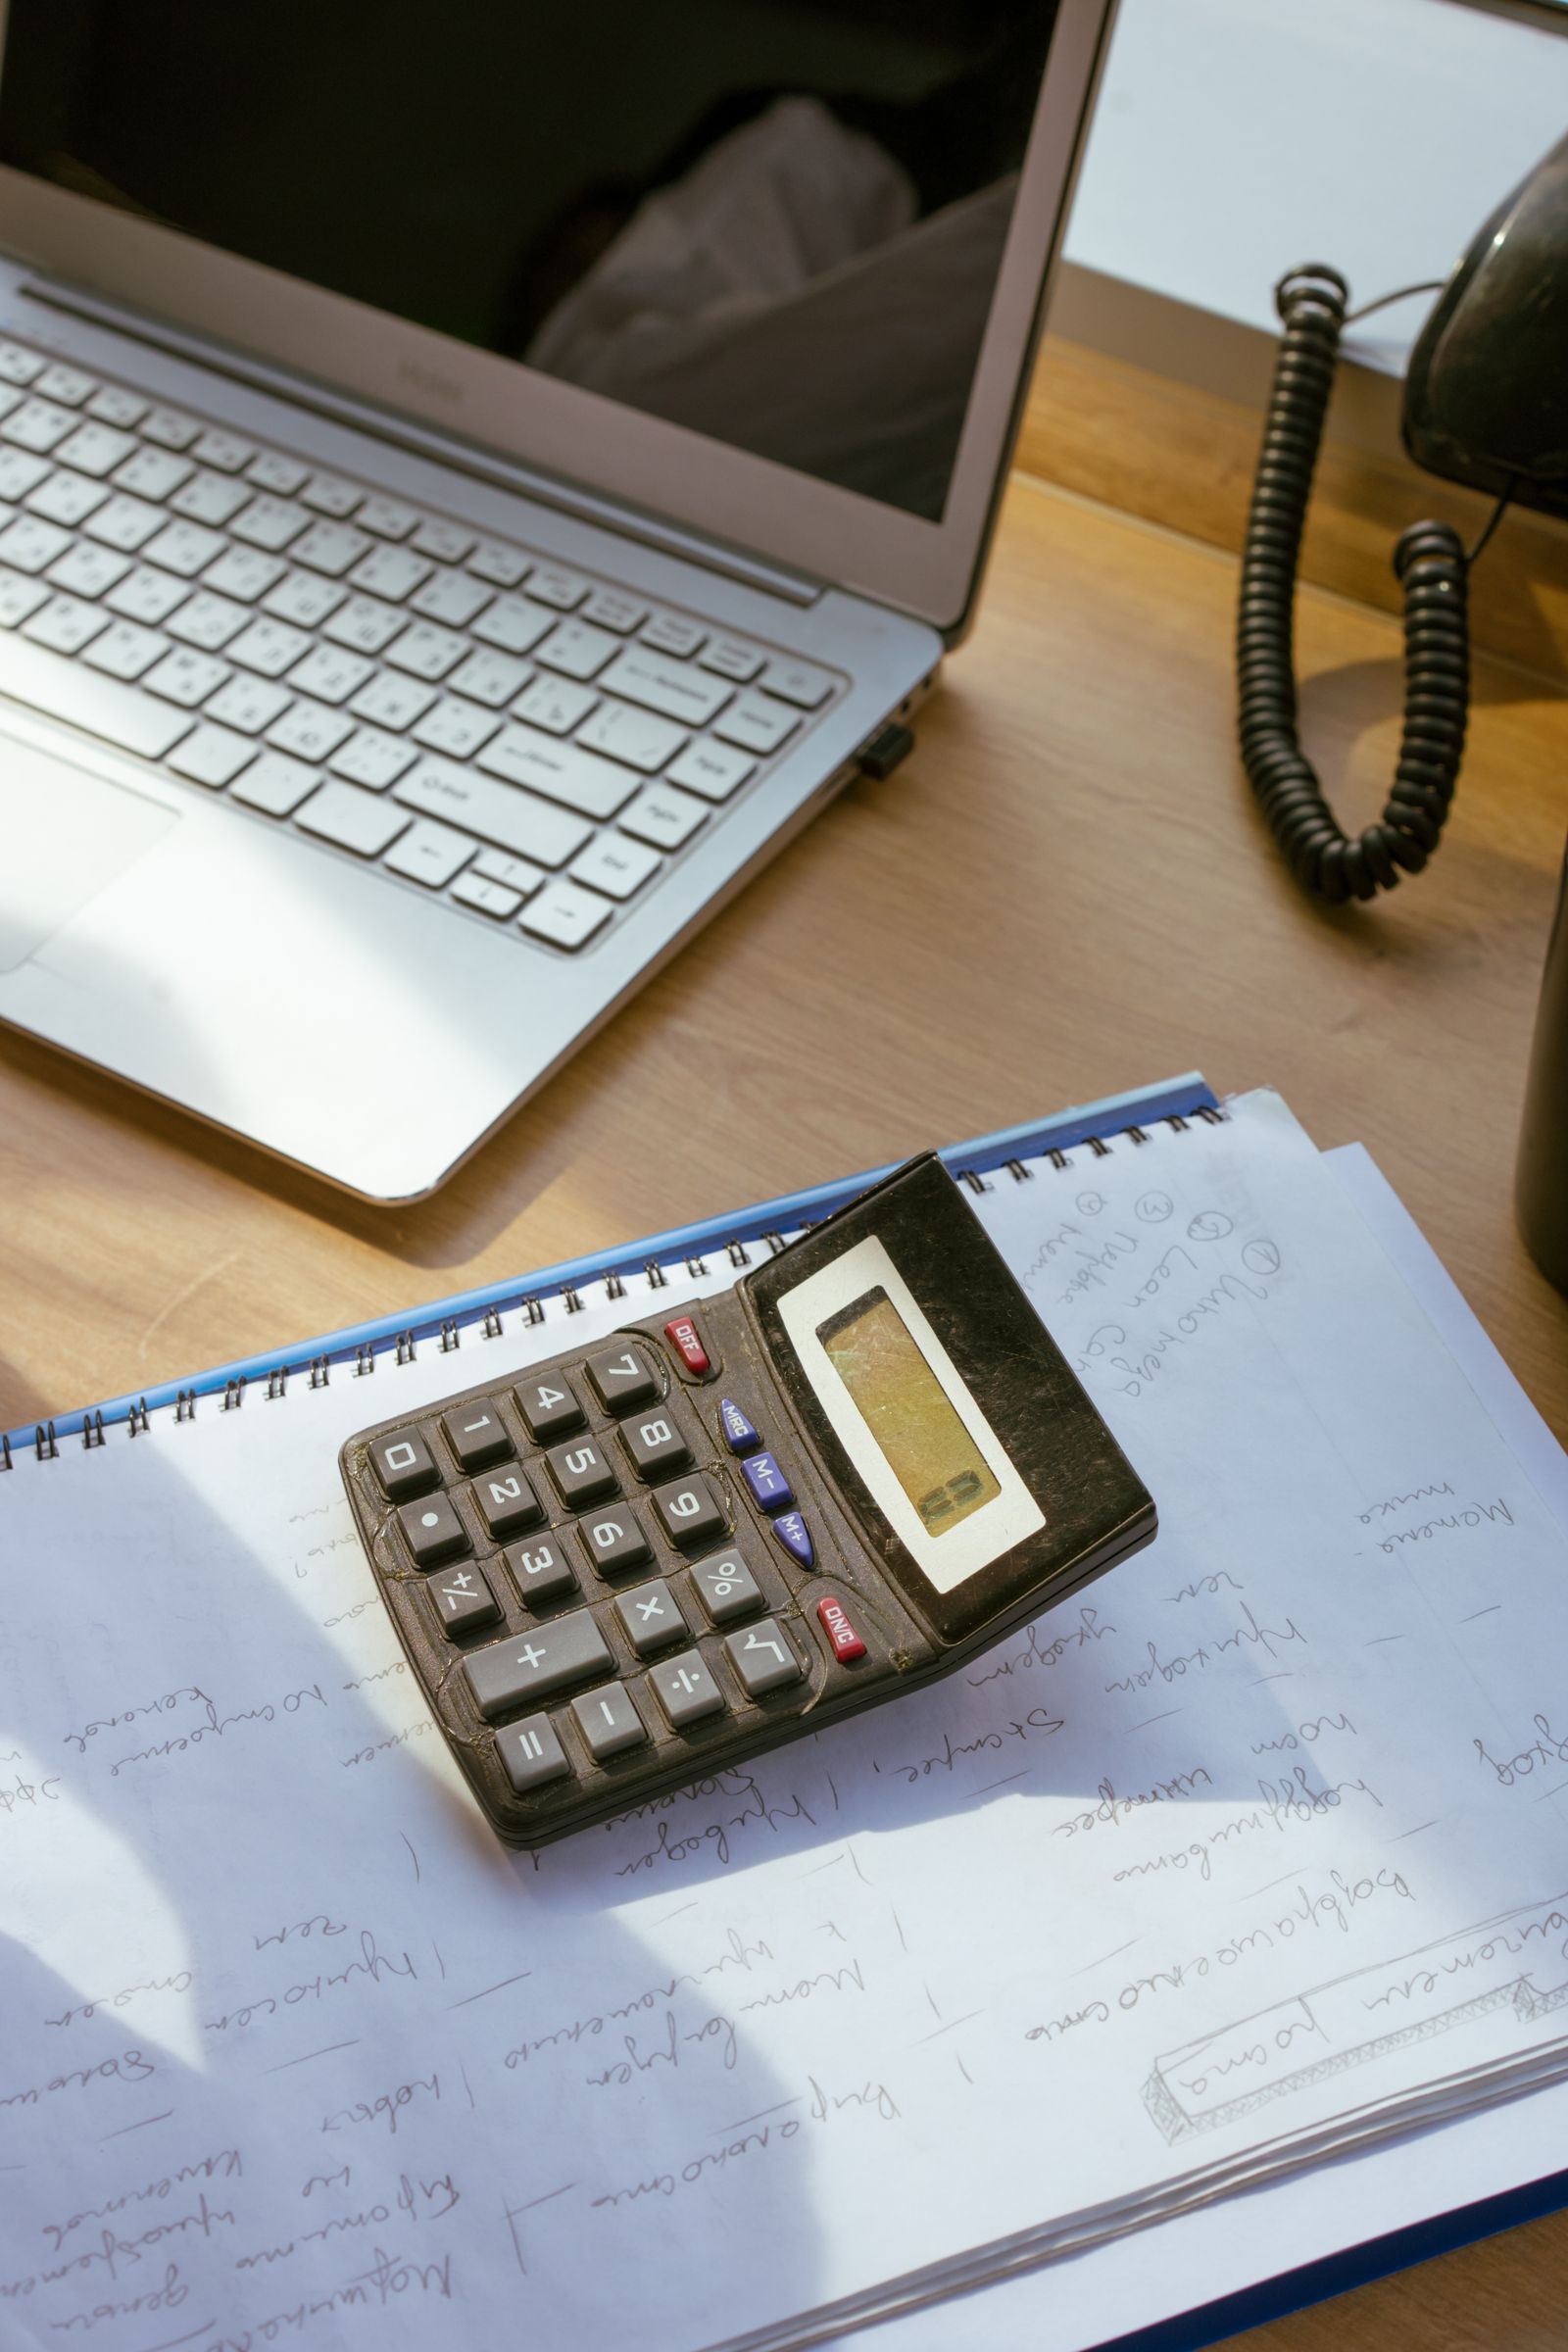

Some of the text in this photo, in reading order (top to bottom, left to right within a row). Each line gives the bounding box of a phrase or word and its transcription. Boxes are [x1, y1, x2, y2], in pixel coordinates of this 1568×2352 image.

[675, 1324, 700, 1352] OFF
[1072, 1324, 1126, 1373] Can
[609, 1354, 639, 1374] 7
[538, 1387, 564, 1408] 4
[465, 1416, 490, 1432] 1
[641, 1420, 671, 1446] 8
[723, 1404, 750, 1438] MRC
[385, 1443, 416, 1470] 0
[565, 1448, 596, 1473] 5
[489, 1478, 520, 1503] 2
[669, 1493, 700, 1516] 9
[594, 1523, 623, 1547] 6
[782, 1516, 803, 1541] M+
[522, 1547, 553, 1574] 3
[714, 1563, 743, 1594] %
[825, 1607, 854, 1643] ON/C
[0, 2049, 157, 2107] больш
[0, 2192, 236, 2302] приобретен
